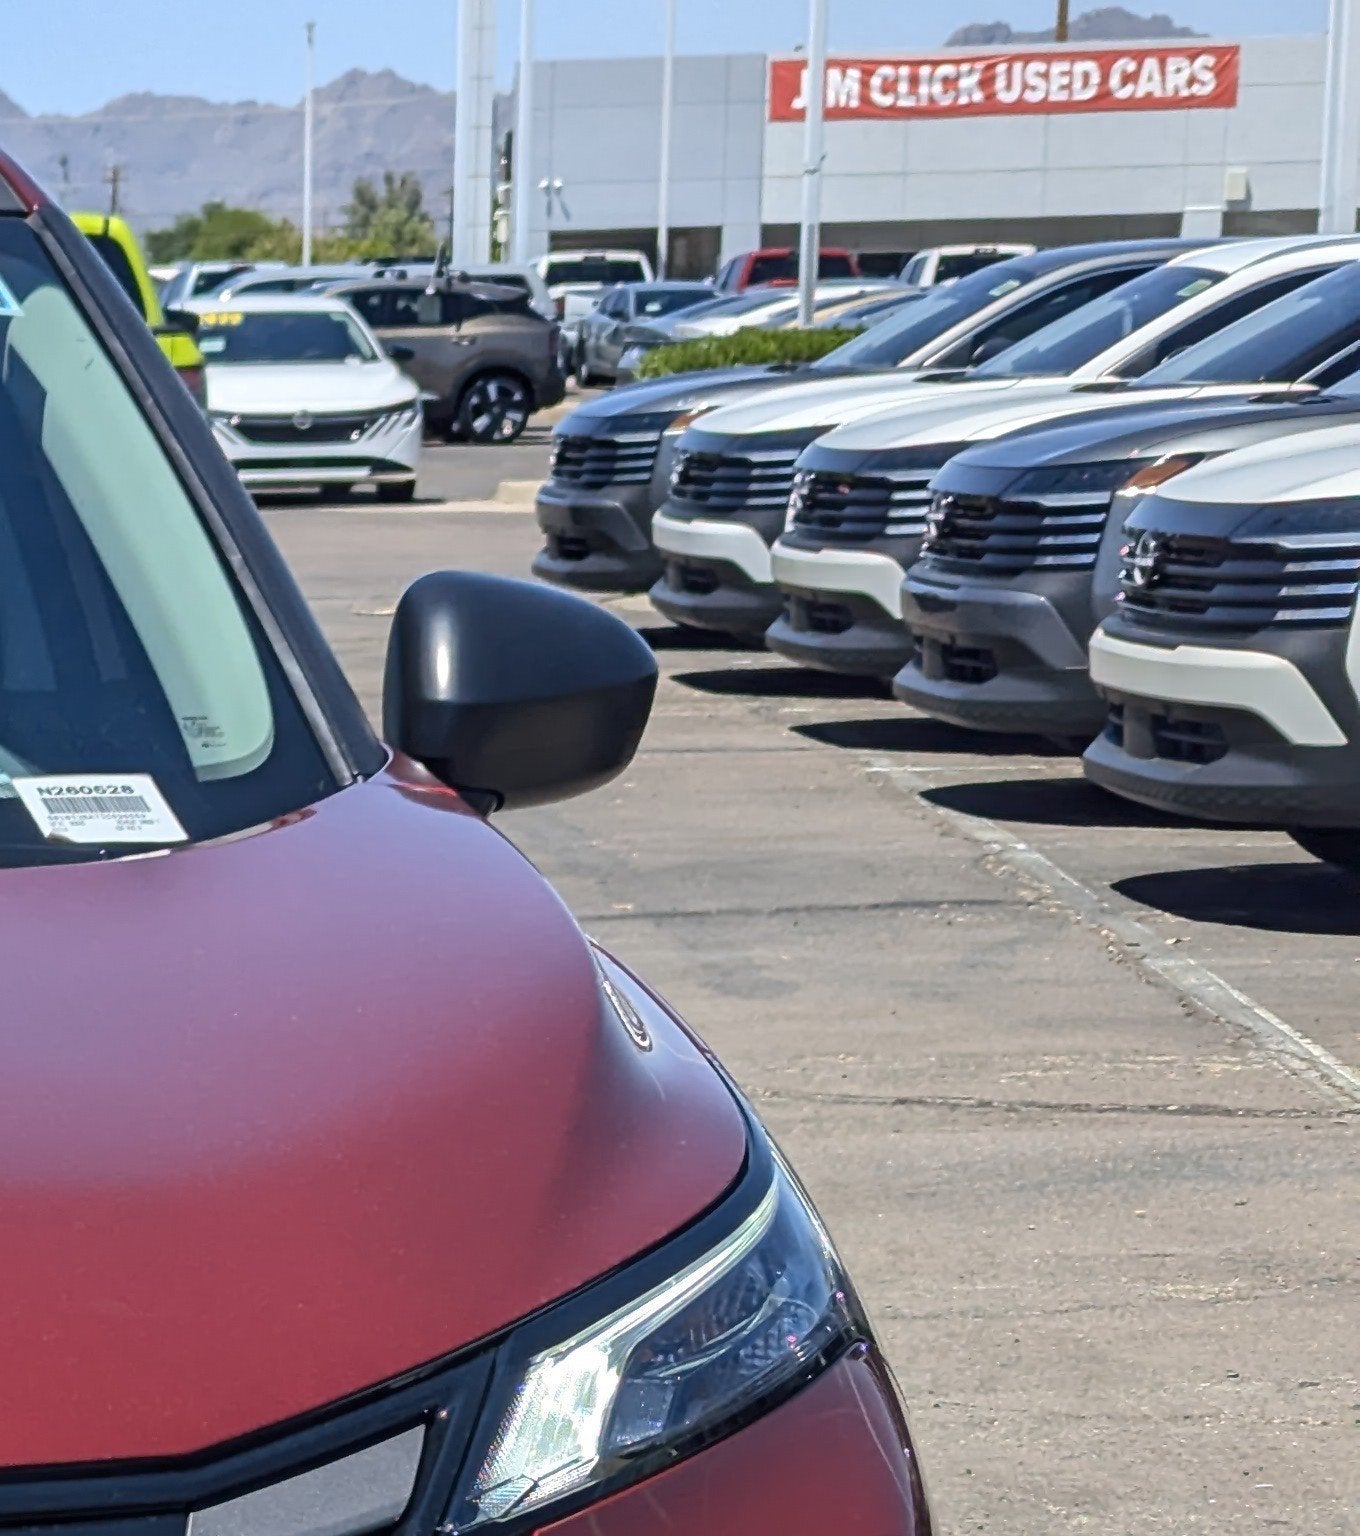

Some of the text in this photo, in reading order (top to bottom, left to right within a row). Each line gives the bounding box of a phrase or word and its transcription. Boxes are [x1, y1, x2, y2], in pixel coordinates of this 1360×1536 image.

[791, 53, 1217, 109] JM CLICK USED CARS
